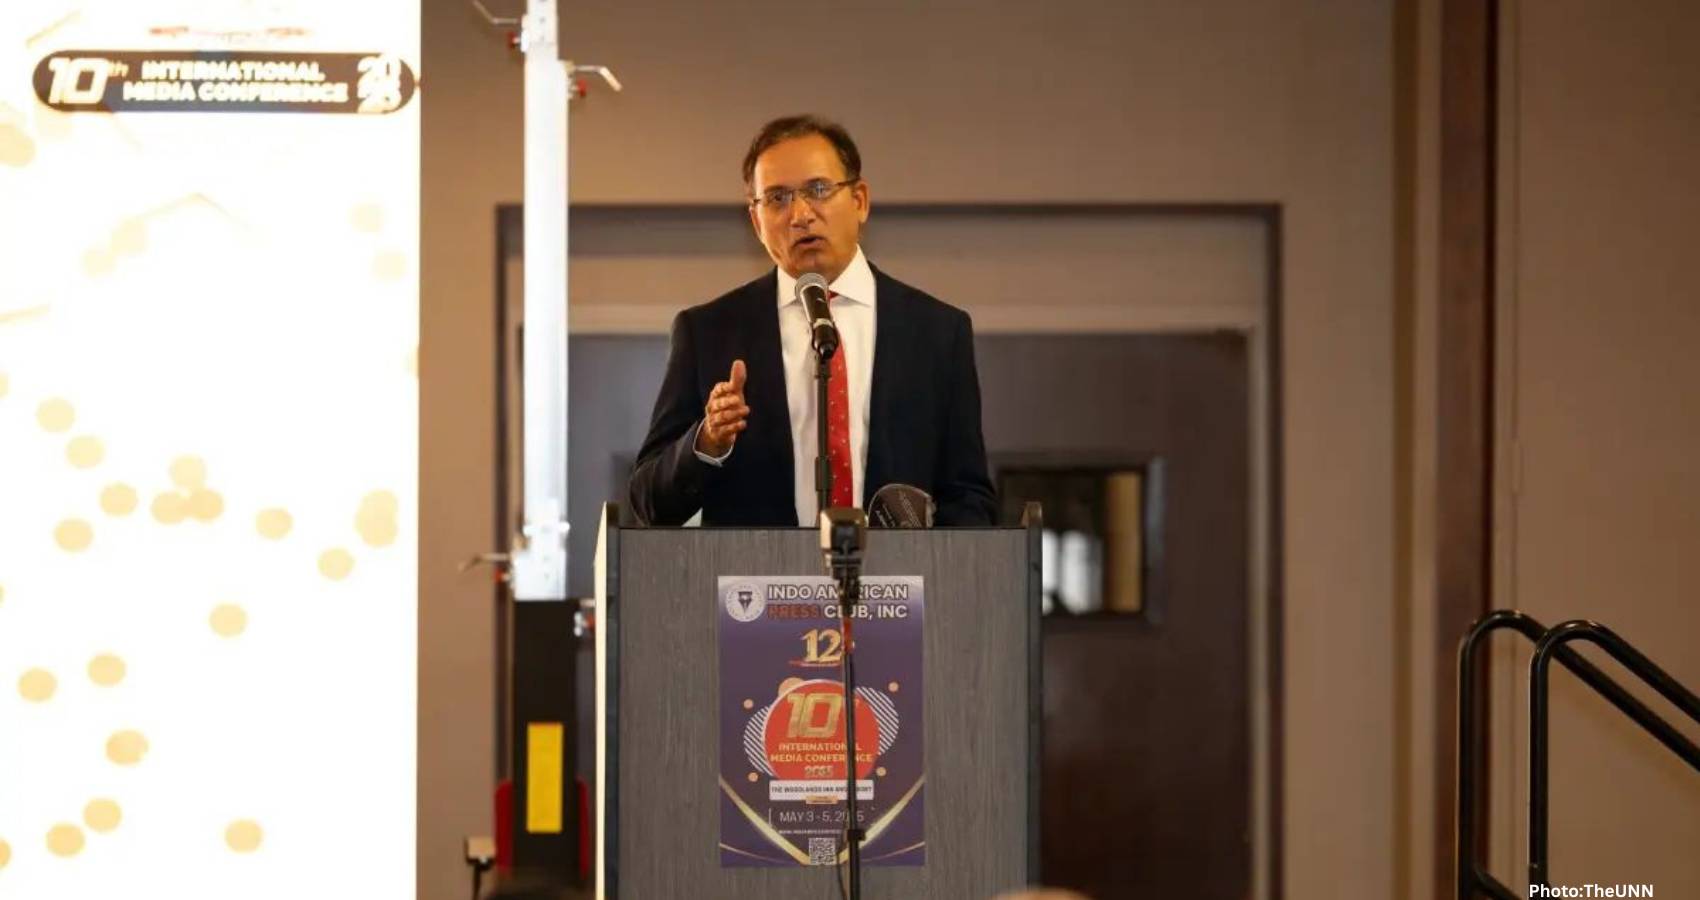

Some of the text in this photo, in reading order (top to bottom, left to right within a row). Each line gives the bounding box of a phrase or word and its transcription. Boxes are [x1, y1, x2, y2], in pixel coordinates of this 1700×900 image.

[141, 61, 326, 81] INTERNATIONAL
[122, 82, 349, 103] MEDIA CONFERENCE
[768, 585, 908, 600] INDO AMICAN
[768, 604, 820, 619] PRESS
[877, 605, 908, 619] INC
[779, 742, 862, 751] INTERNATIONL
[770, 754, 802, 762] MEDIA
[779, 811, 804, 822] MAY
